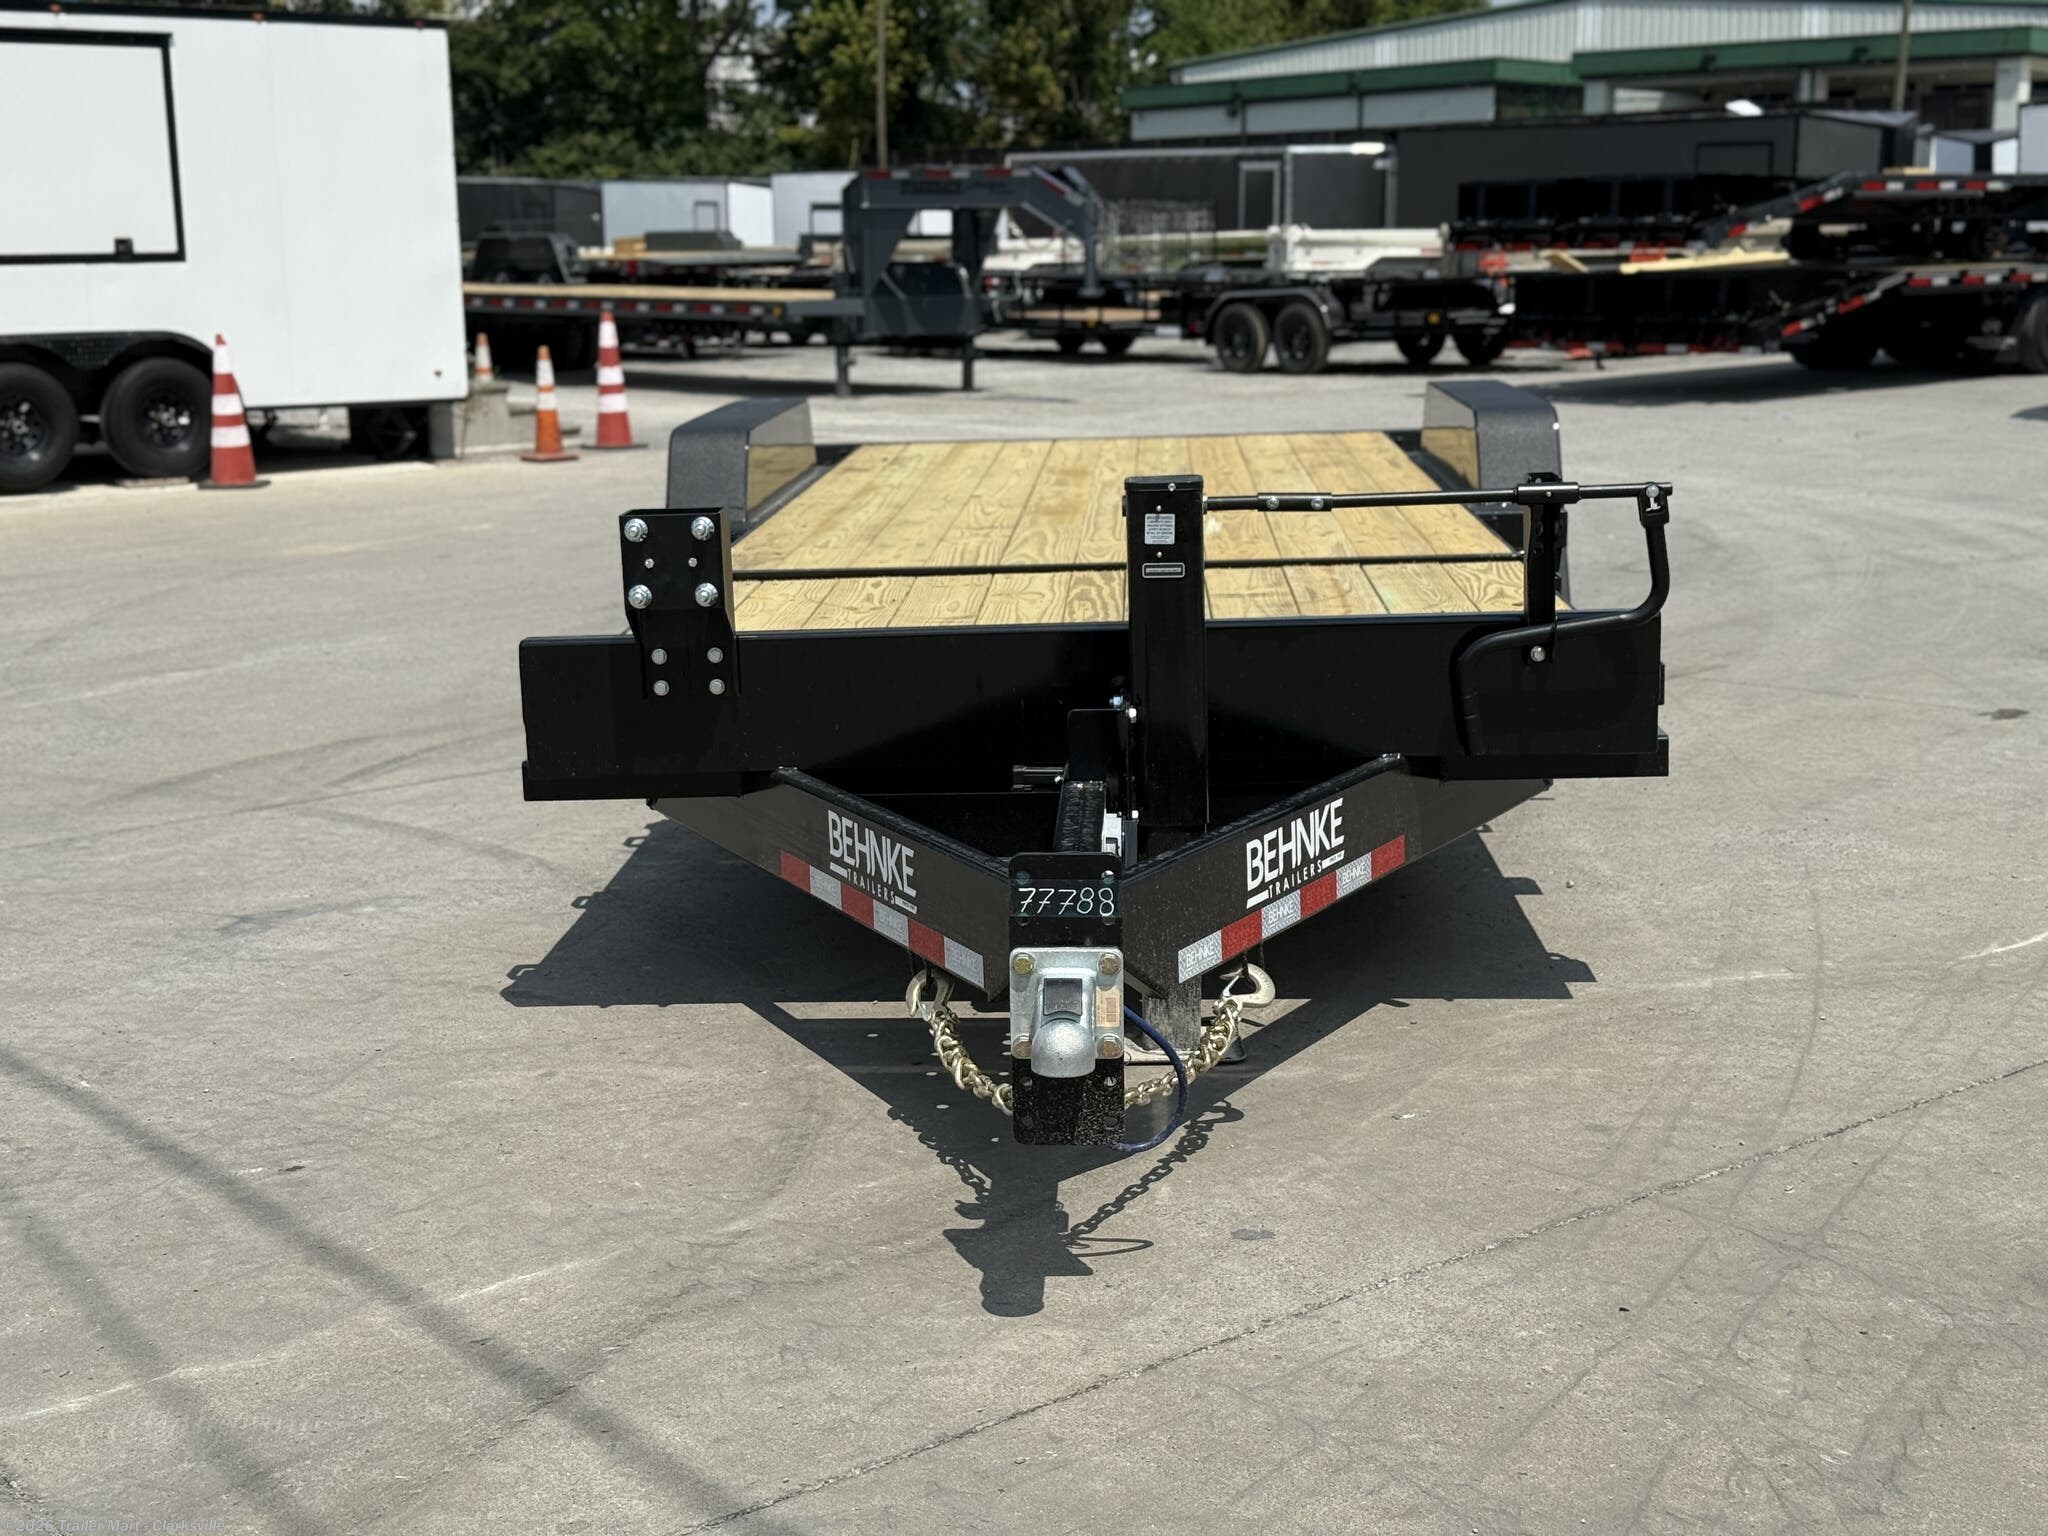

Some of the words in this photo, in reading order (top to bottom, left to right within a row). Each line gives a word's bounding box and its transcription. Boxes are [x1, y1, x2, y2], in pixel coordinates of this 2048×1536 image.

[828, 810, 917, 898] BEHNKE
[1246, 797, 1345, 891] BEHNKE
[847, 868, 895, 904] TRAILERS
[1269, 859, 1322, 898] TRAILERS
[1018, 886, 1115, 916] 77788
[1268, 900, 1294, 923] BEHNKE
[1186, 941, 1215, 967] BEHNKE
